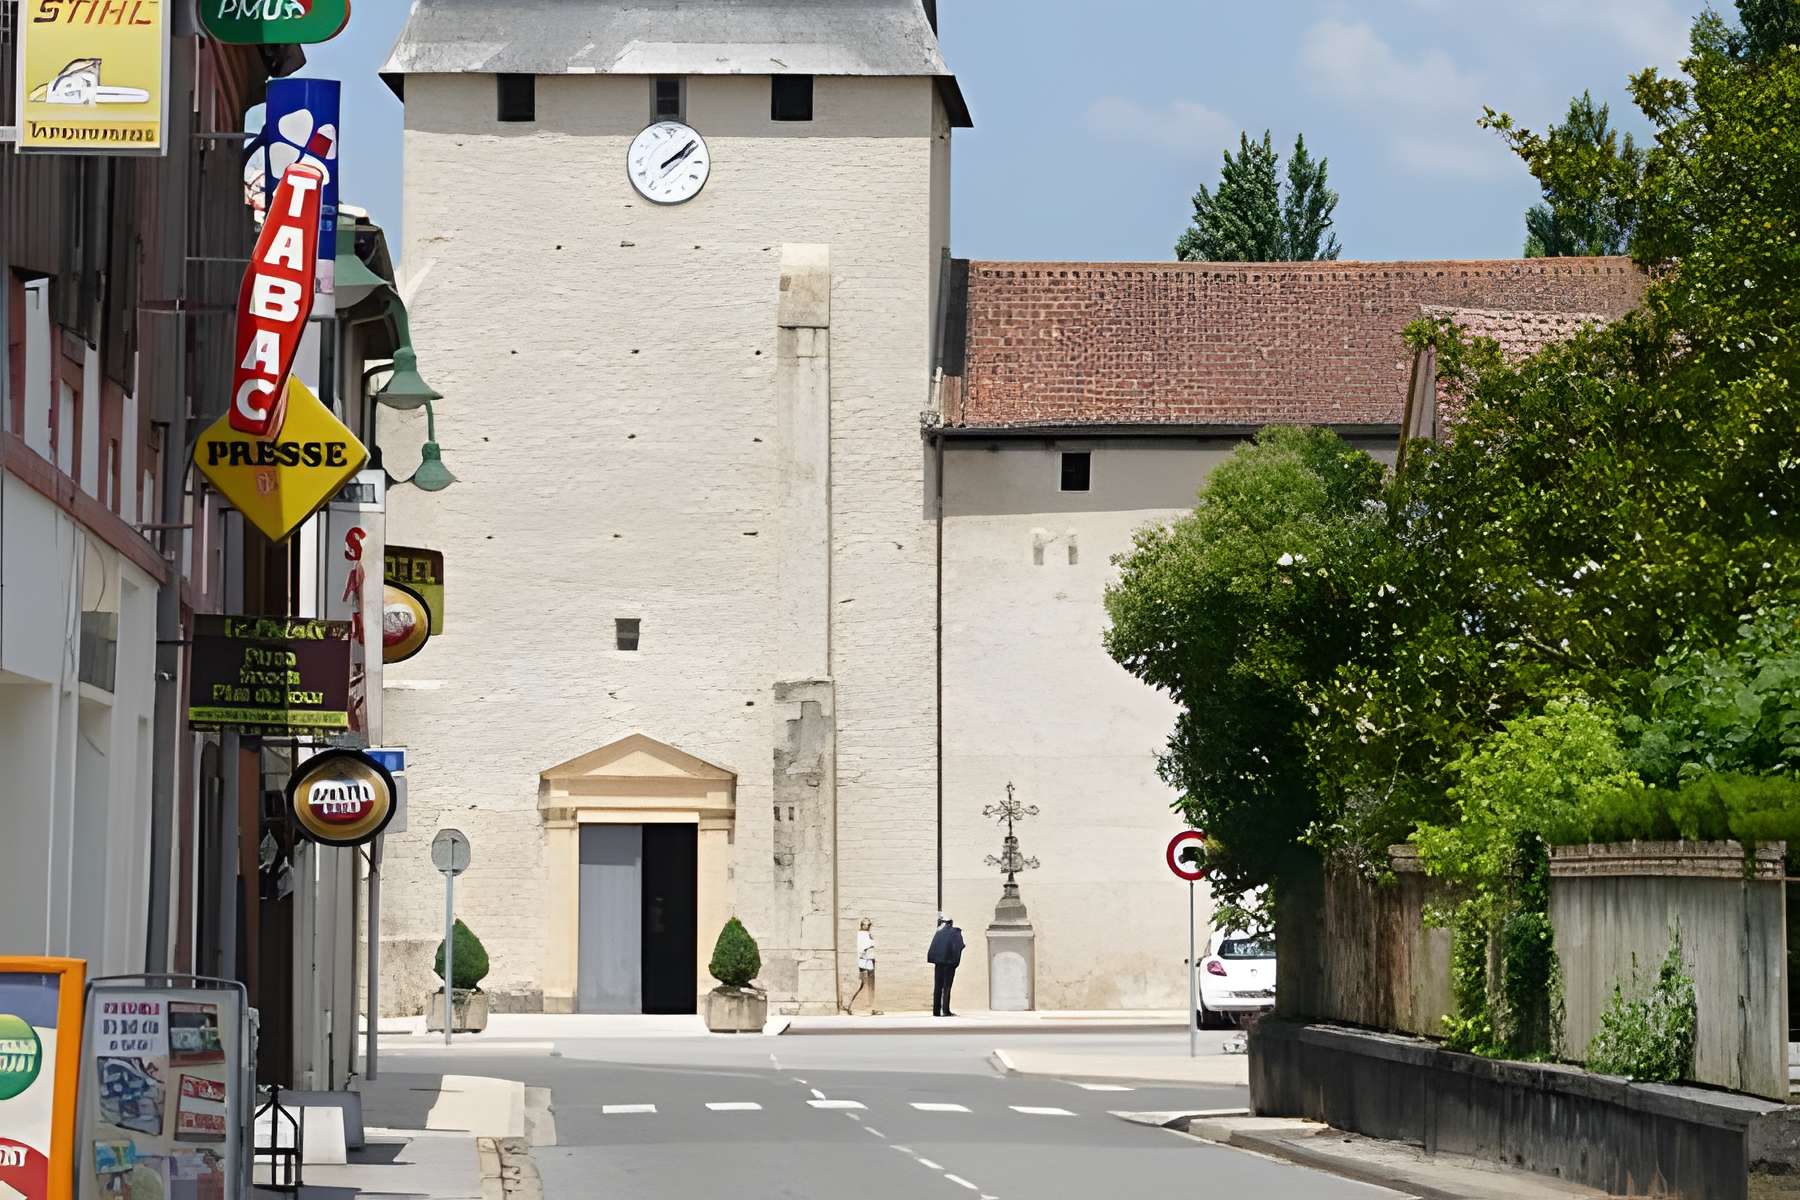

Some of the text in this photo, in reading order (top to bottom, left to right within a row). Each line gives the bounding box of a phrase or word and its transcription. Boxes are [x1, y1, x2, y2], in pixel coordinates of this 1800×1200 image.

[33, 0, 154, 25] STIHL
[236, 174, 318, 421] TABAC
[207, 441, 348, 467] PRESSE
